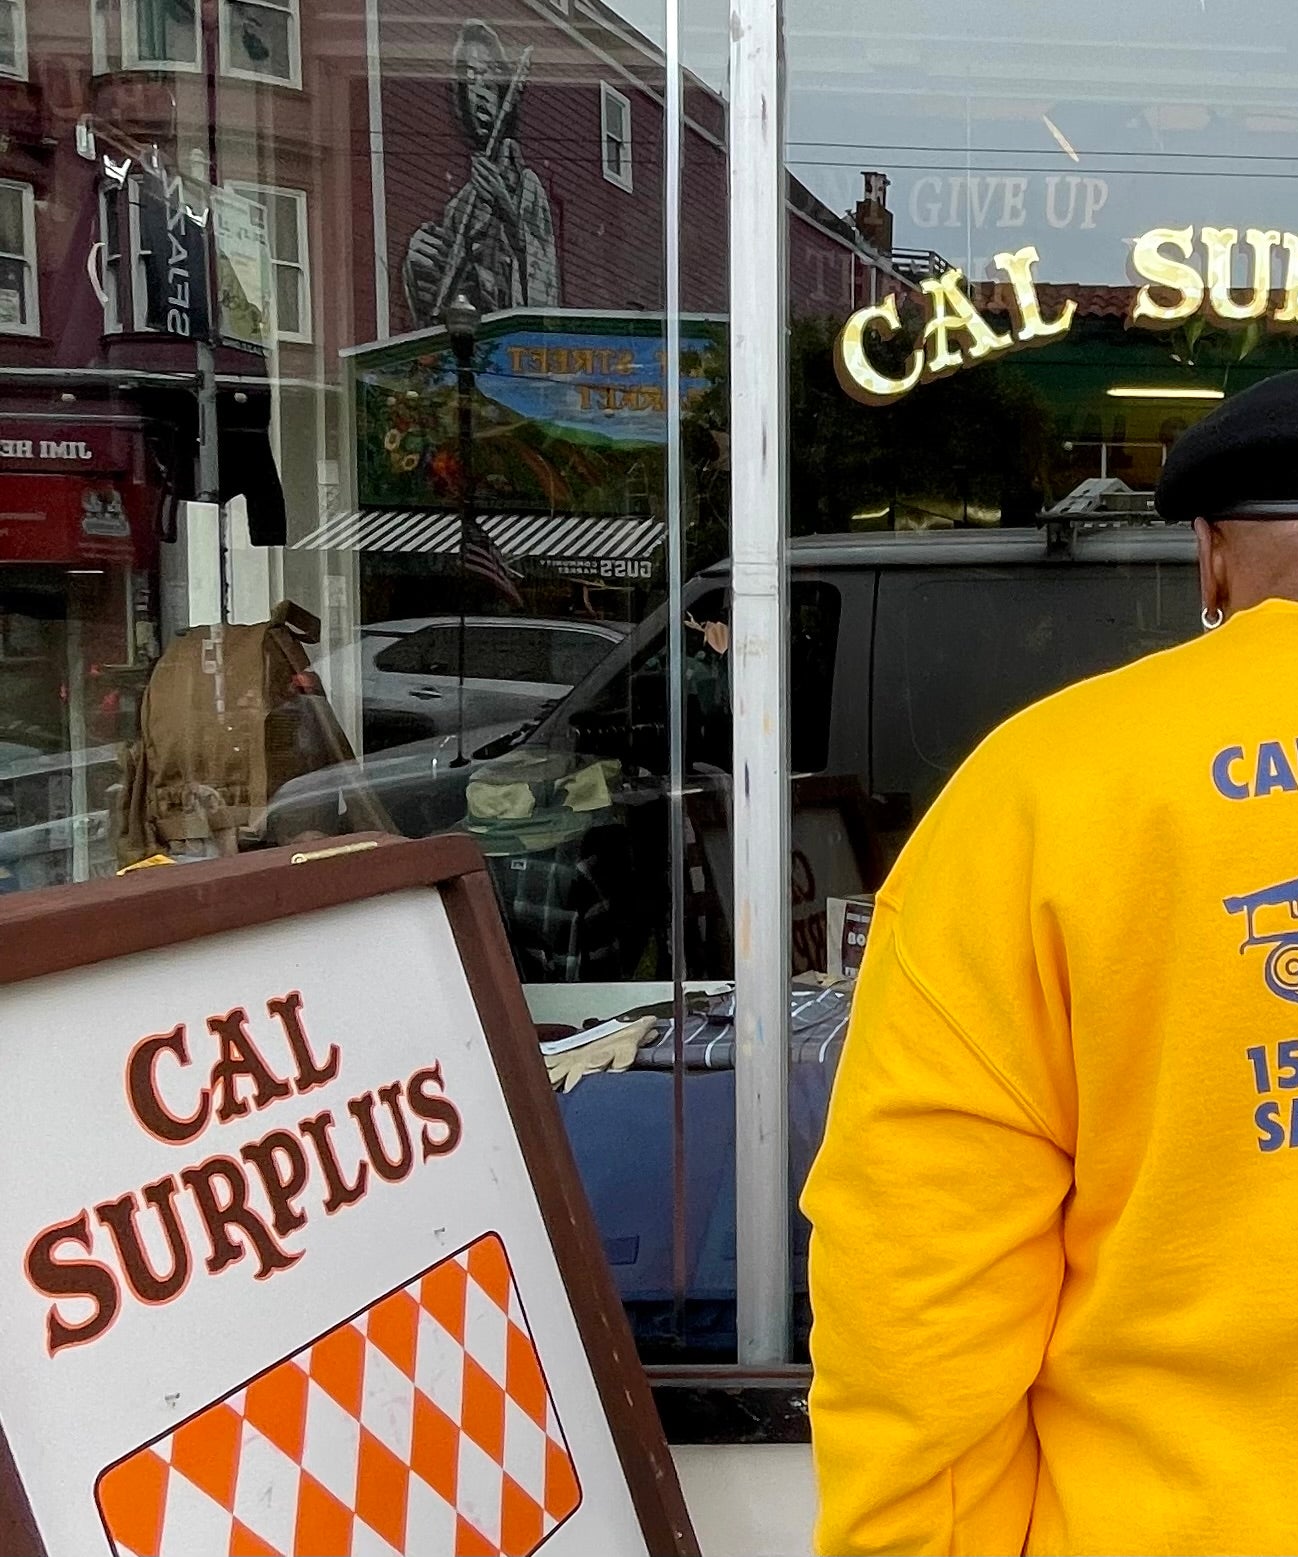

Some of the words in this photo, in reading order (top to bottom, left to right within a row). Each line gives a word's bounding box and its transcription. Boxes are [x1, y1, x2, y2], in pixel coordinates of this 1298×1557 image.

[908, 175, 1028, 230] GIVE
[1045, 174, 1109, 230] UP
[838, 245, 1078, 400] CAL
[125, 990, 341, 1146] CAL
[23, 1060, 464, 1358] SURPLUS
